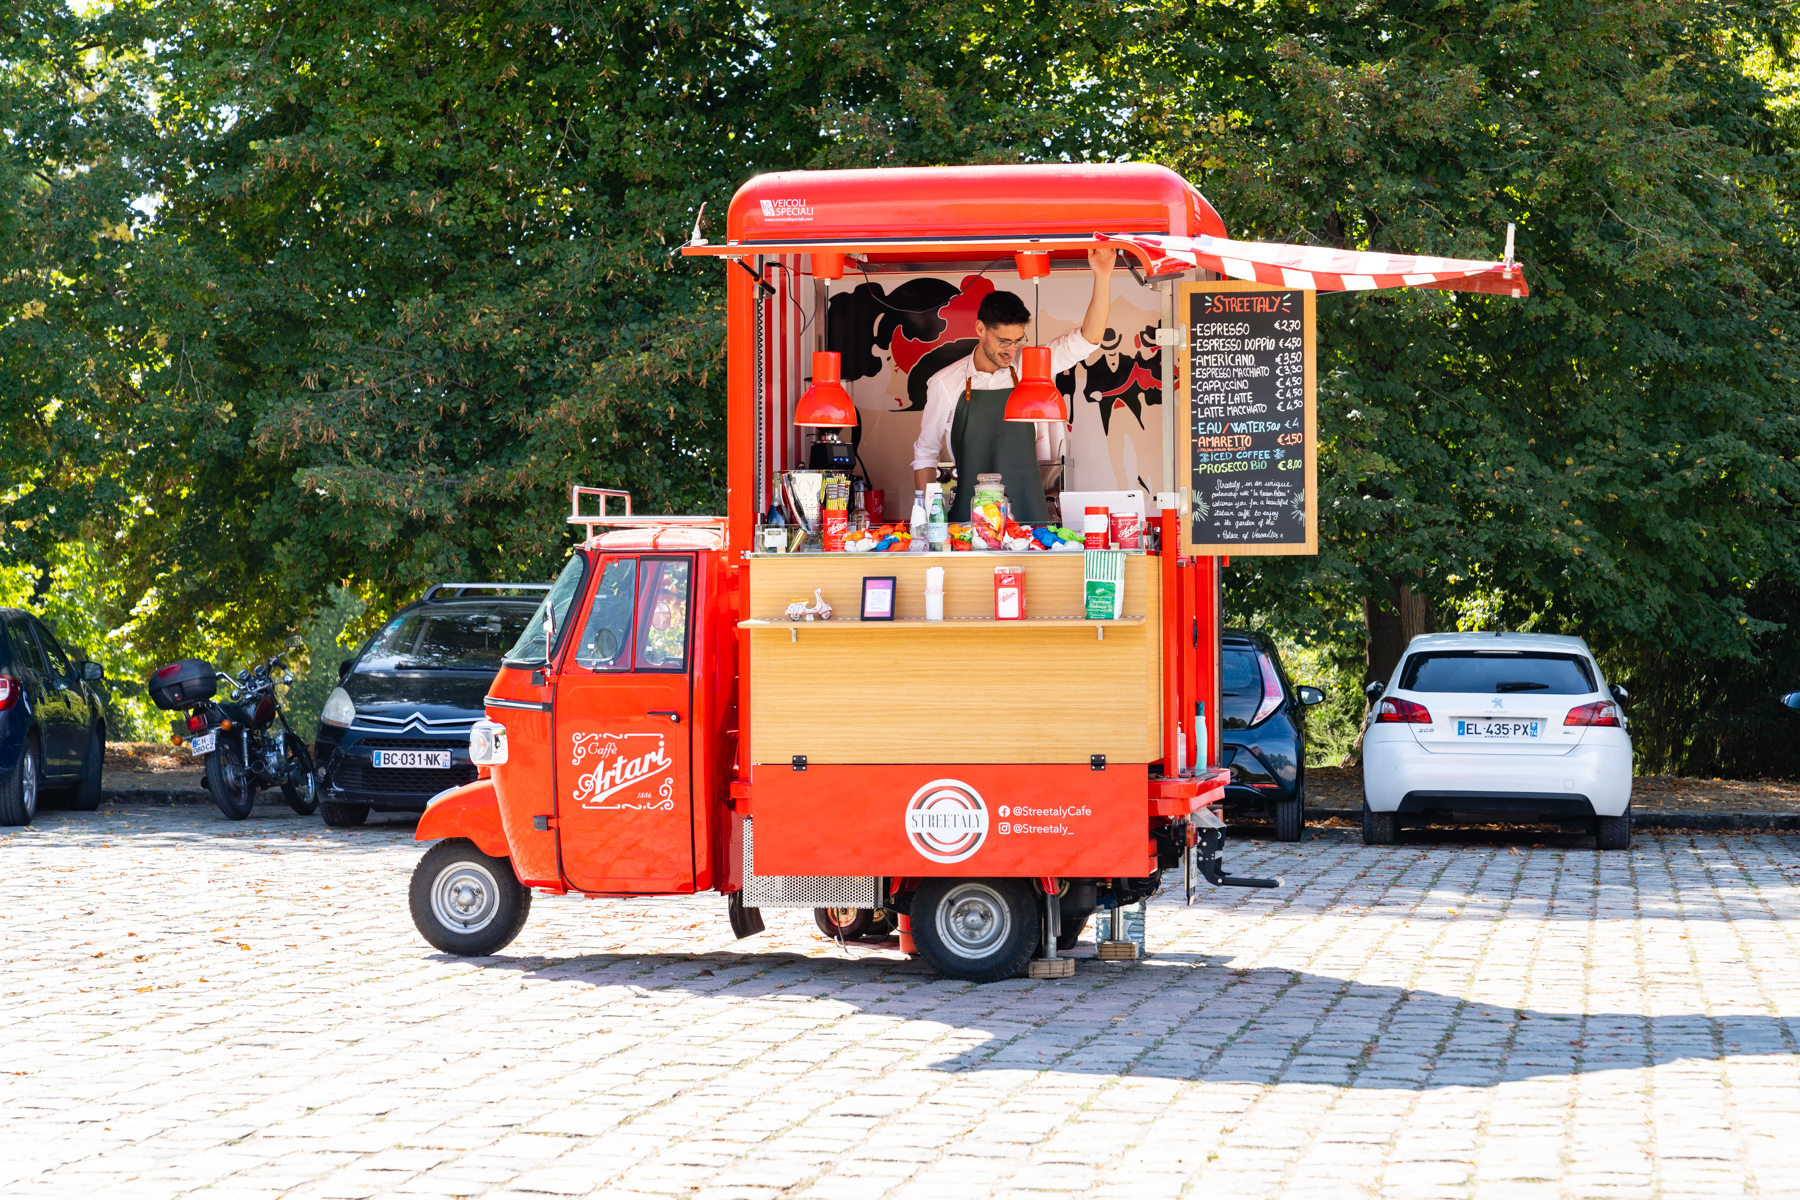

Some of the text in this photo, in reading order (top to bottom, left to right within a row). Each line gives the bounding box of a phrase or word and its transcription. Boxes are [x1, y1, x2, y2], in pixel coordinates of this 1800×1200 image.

[772, 199, 806, 207] VEICOLI
[776, 207, 814, 216] SPECIALI
[1213, 295, 1281, 313] STREETALY
[1196, 322, 1250, 336] ESPRESSO
[1196, 338, 1242, 352] ESPRESSO
[1244, 336, 1276, 351] DOPPIO
[1196, 367, 1231, 379] ESPRESSO
[1232, 366, 1270, 378] MACCHIATO
[1196, 379, 1249, 392] CAPPUCCINO
[1228, 392, 1253, 404] LATTE
[1198, 406, 1225, 418] LATTE
[1226, 402, 1267, 417] MACCHIATO
[1197, 434, 1252, 448] AMARETTO
[1211, 450, 1271, 461] ICED COFFEE
[1198, 461, 1248, 474] PROSECCO
[1250, 460, 1267, 470] BIO
[1264, 479, 1292, 490] unique
[1234, 501, 1248, 509] you
[1248, 498, 1259, 508] for
[1262, 507, 1279, 520] enjoy
[1234, 519, 1255, 529] garden
[1466, 723, 1529, 736] EL-435-PX
[588, 742, 618, 759] Caffè
[383, 753, 441, 766] BC-031-NK
[573, 740, 672, 803] Artari
[1013, 805, 1092, 819] @StreetalyCafe
[911, 814, 982, 829] STREETALY
[1013, 823, 1074, 836] @Streetaly_
